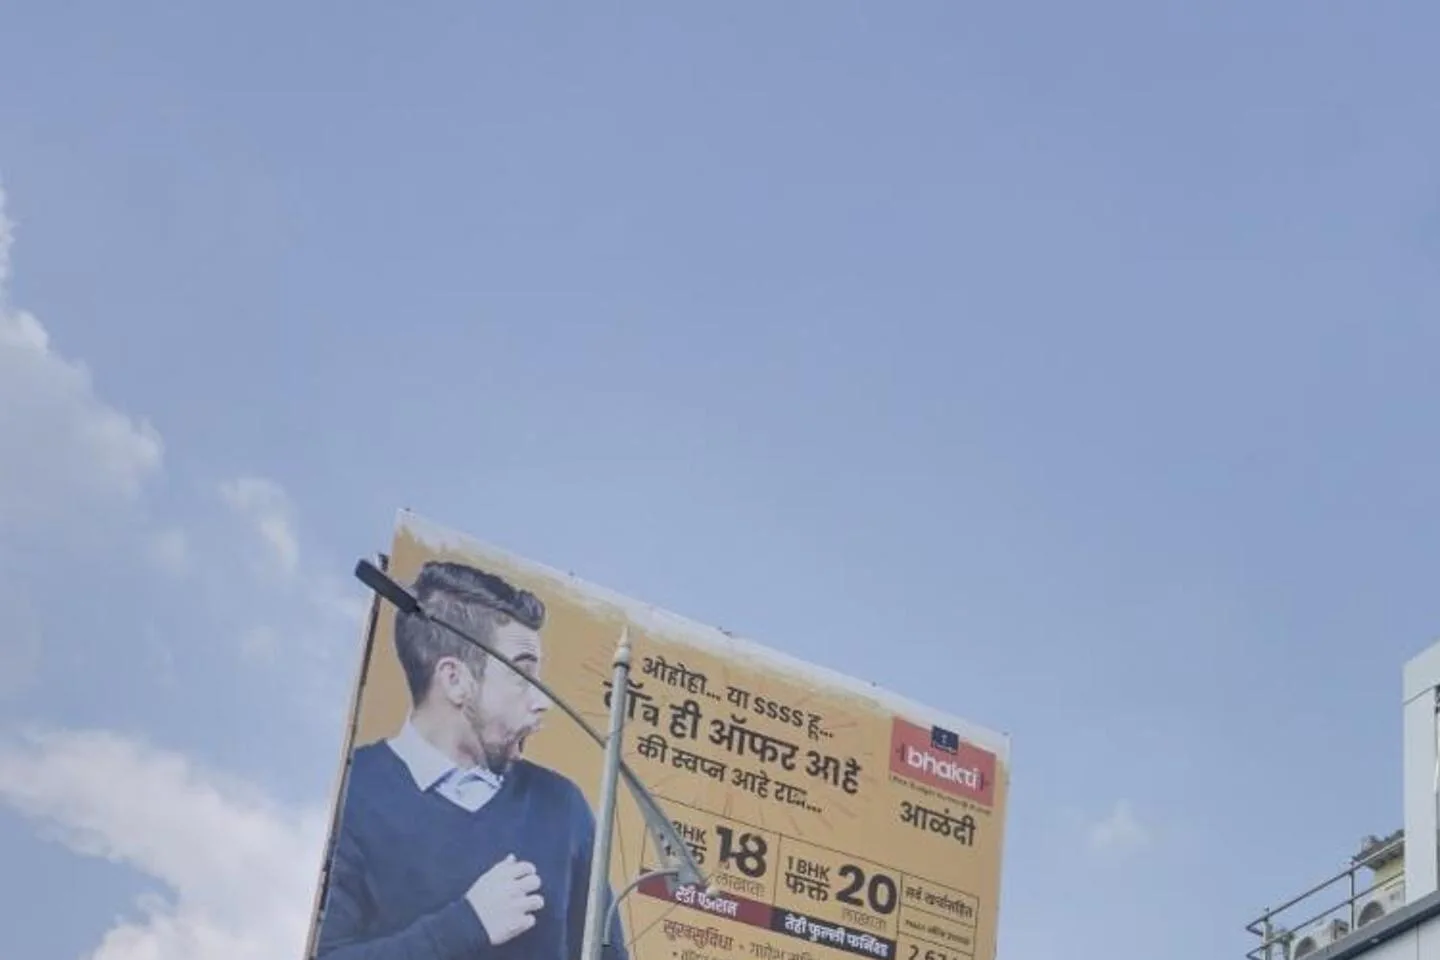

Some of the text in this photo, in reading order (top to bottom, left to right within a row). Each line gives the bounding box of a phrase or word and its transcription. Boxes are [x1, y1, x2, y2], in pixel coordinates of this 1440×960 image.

[637, 734, 668, 764] की
[671, 746, 727, 783] स्वप्न
[732, 768, 771, 799] आहे
[668, 699, 703, 739] ही
[709, 713, 799, 772] ऑफर
[806, 749, 863, 794] आहे
[900, 800, 976, 847] आळंदी
[785, 864, 897, 915] फक्त 20
[797, 859, 831, 882] BHK
